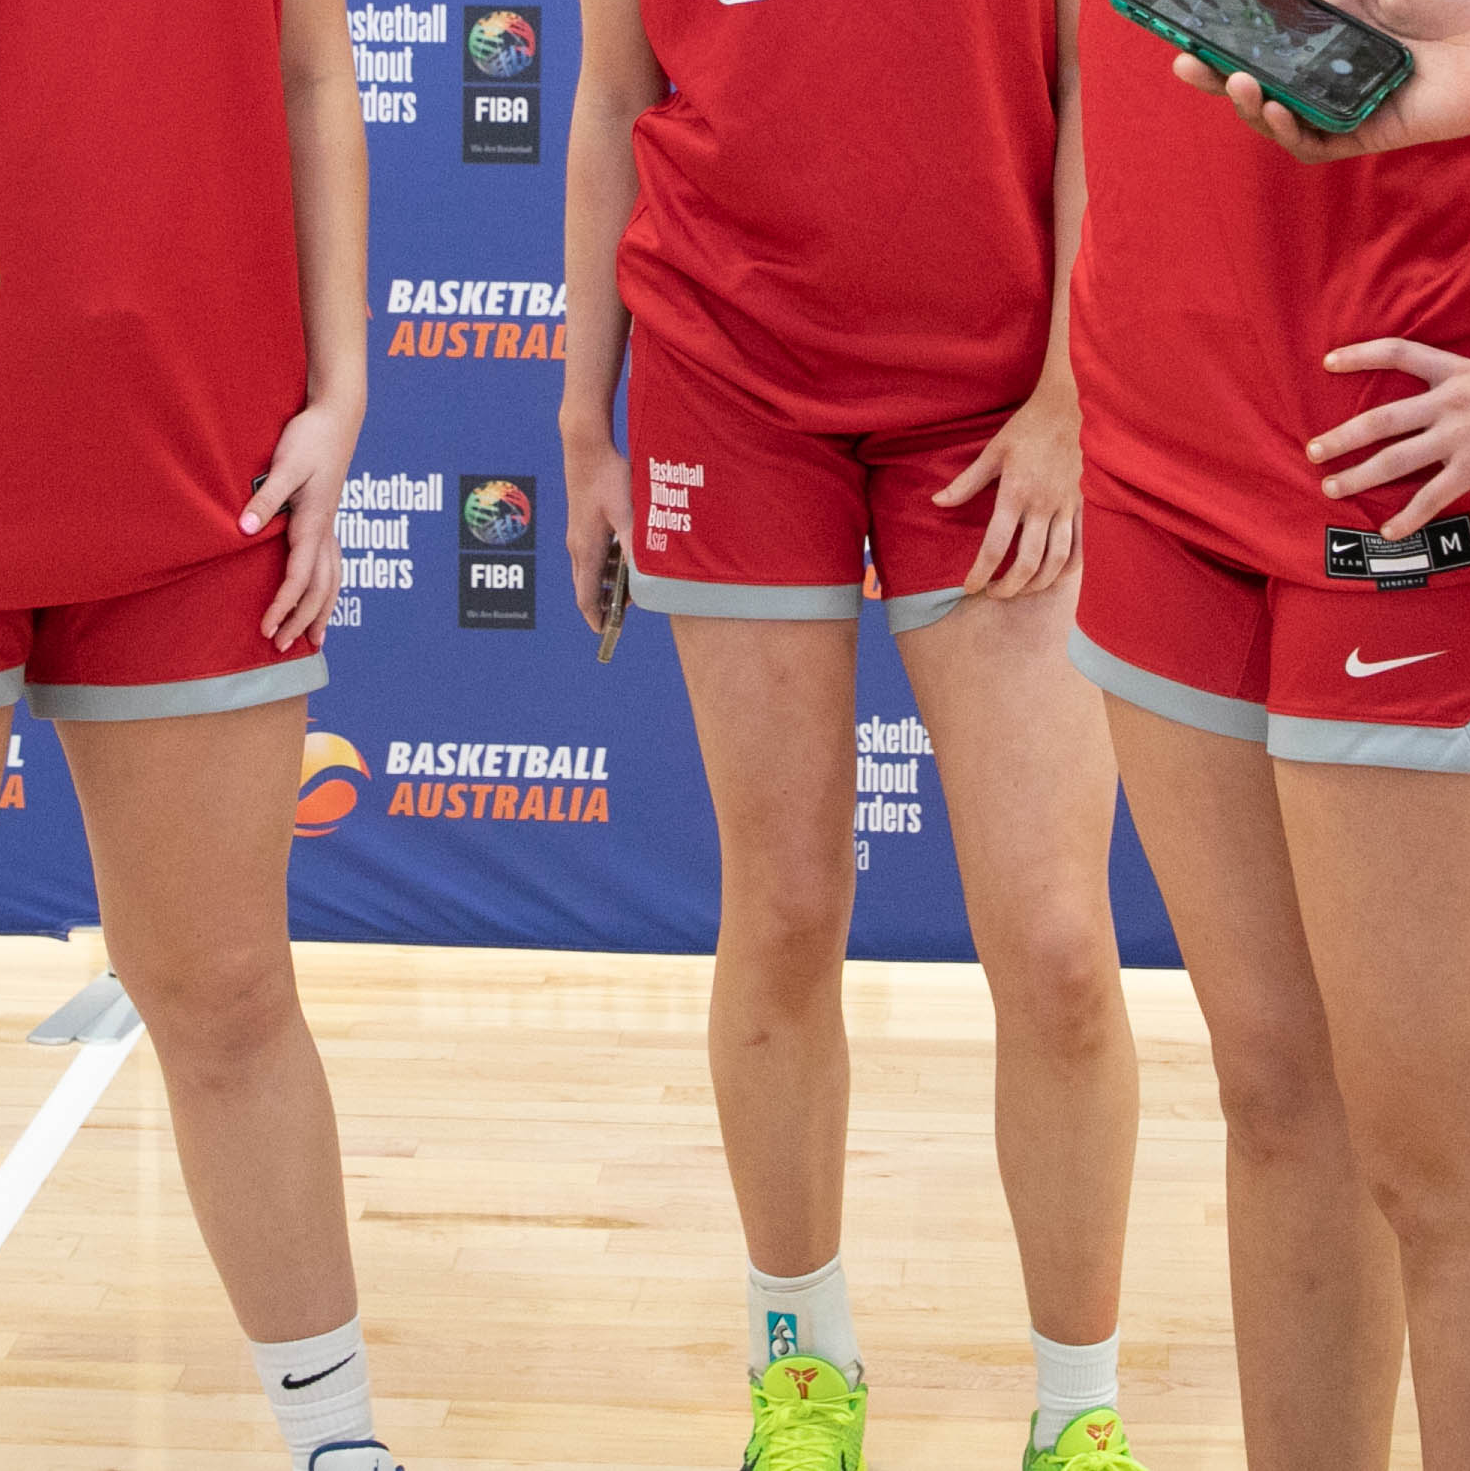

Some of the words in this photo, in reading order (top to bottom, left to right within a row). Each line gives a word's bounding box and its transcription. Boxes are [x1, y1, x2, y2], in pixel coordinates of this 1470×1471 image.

[476, 97, 528, 122] FIBA
[387, 280, 566, 316] BASKETBA
[388, 322, 566, 359] AUSTRAL
[339, 472, 442, 511] asketball
[648, 504, 691, 531] Borders
[646, 527, 667, 552] Asia
[1440, 532, 1462, 556] M
[341, 551, 413, 590] orders
[471, 564, 523, 589] FIBA
[1332, 557, 1363, 566] TEAM
[329, 590, 362, 627] sia
[386, 742, 608, 780] BASKETBALL
[857, 755, 918, 793] thout
[389, 783, 608, 822] AUSTRALIA
[855, 795, 921, 833] rders
